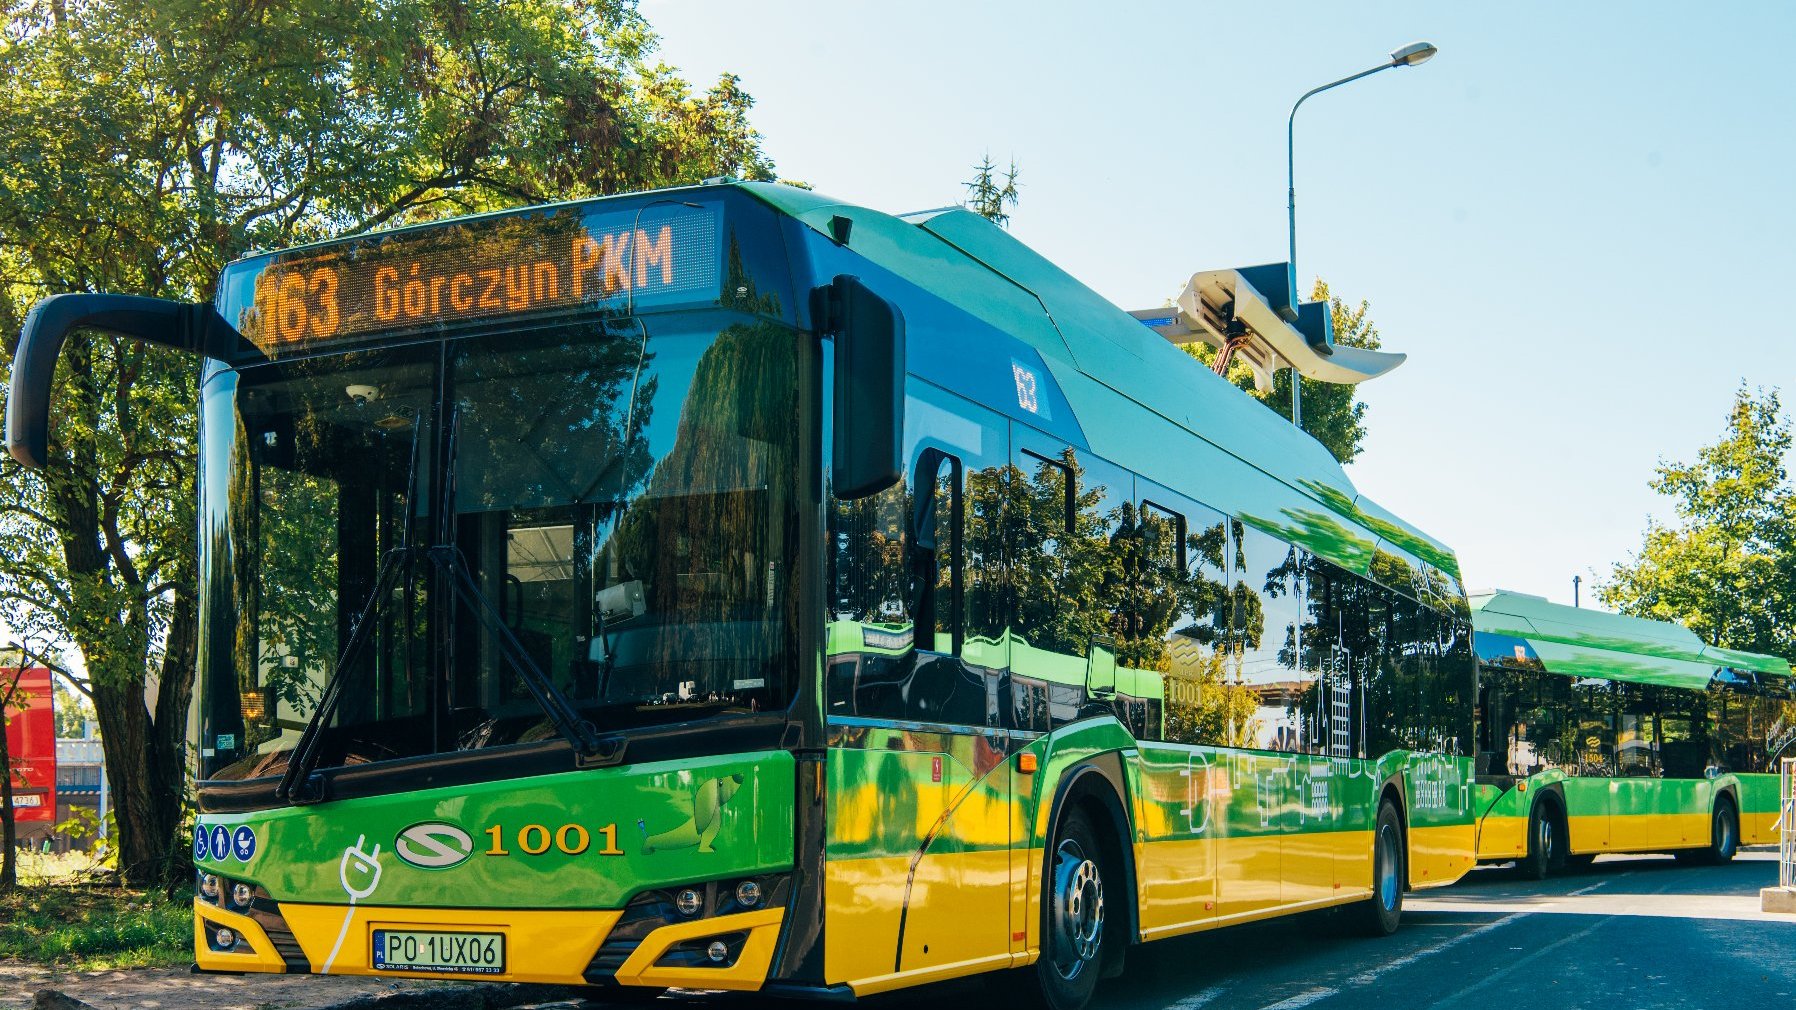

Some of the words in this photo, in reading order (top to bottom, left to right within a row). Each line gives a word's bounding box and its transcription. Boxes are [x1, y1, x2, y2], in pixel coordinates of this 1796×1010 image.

[256, 267, 340, 345] 163
[374, 260, 559, 322] Górczyn
[571, 224, 674, 299] PKM
[1169, 678, 1203, 708] 1001
[485, 823, 625, 857] 1001
[376, 950, 384, 959] PL
[428, 936, 496, 964] 1UX06
